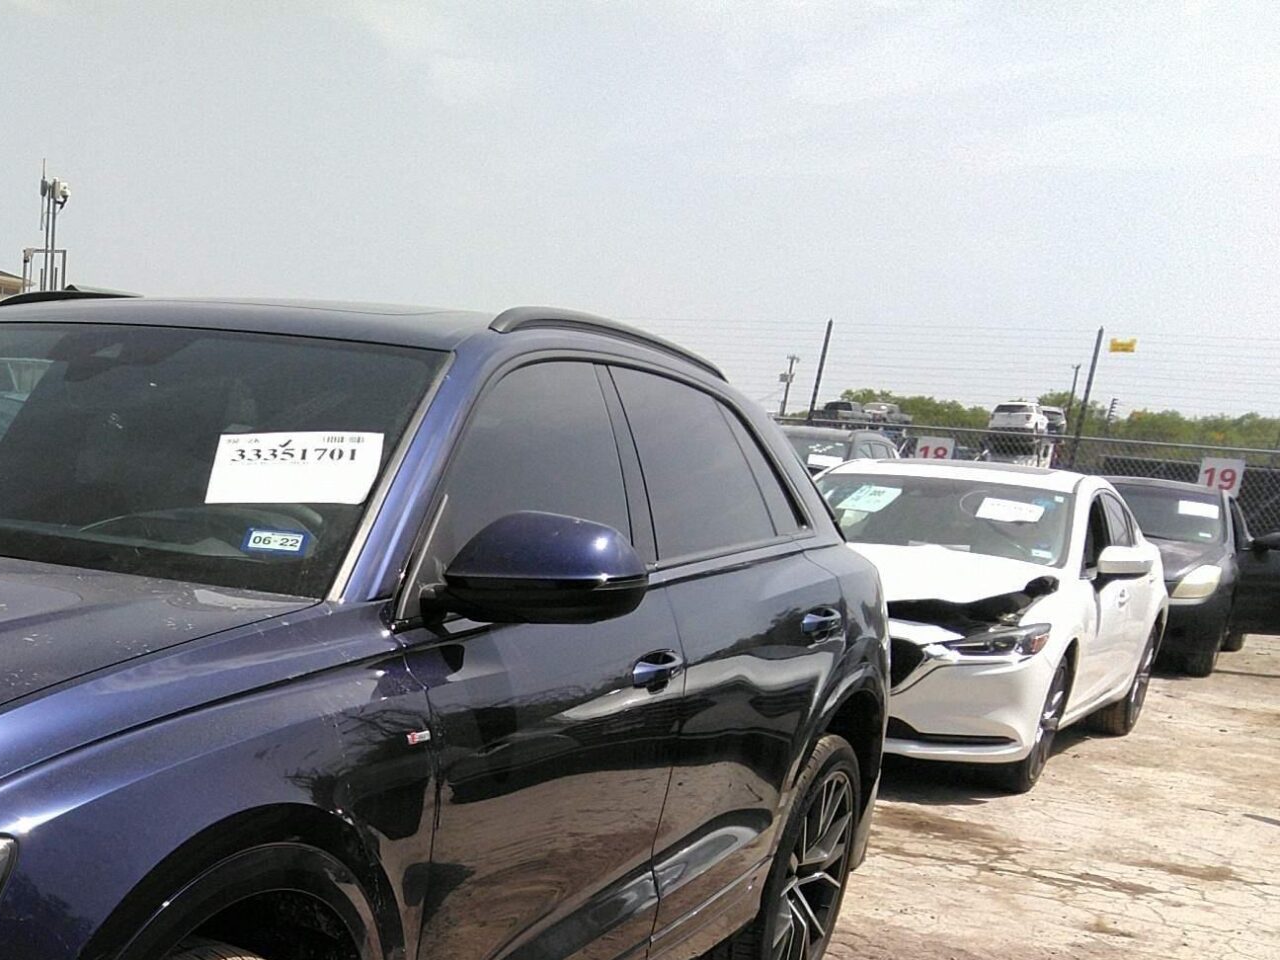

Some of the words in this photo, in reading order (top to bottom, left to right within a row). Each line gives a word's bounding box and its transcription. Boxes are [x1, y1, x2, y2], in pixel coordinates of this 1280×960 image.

[231, 448, 357, 461] 33351701
[1204, 467, 1237, 490] 19
[252, 535, 300, 548] 06-22
